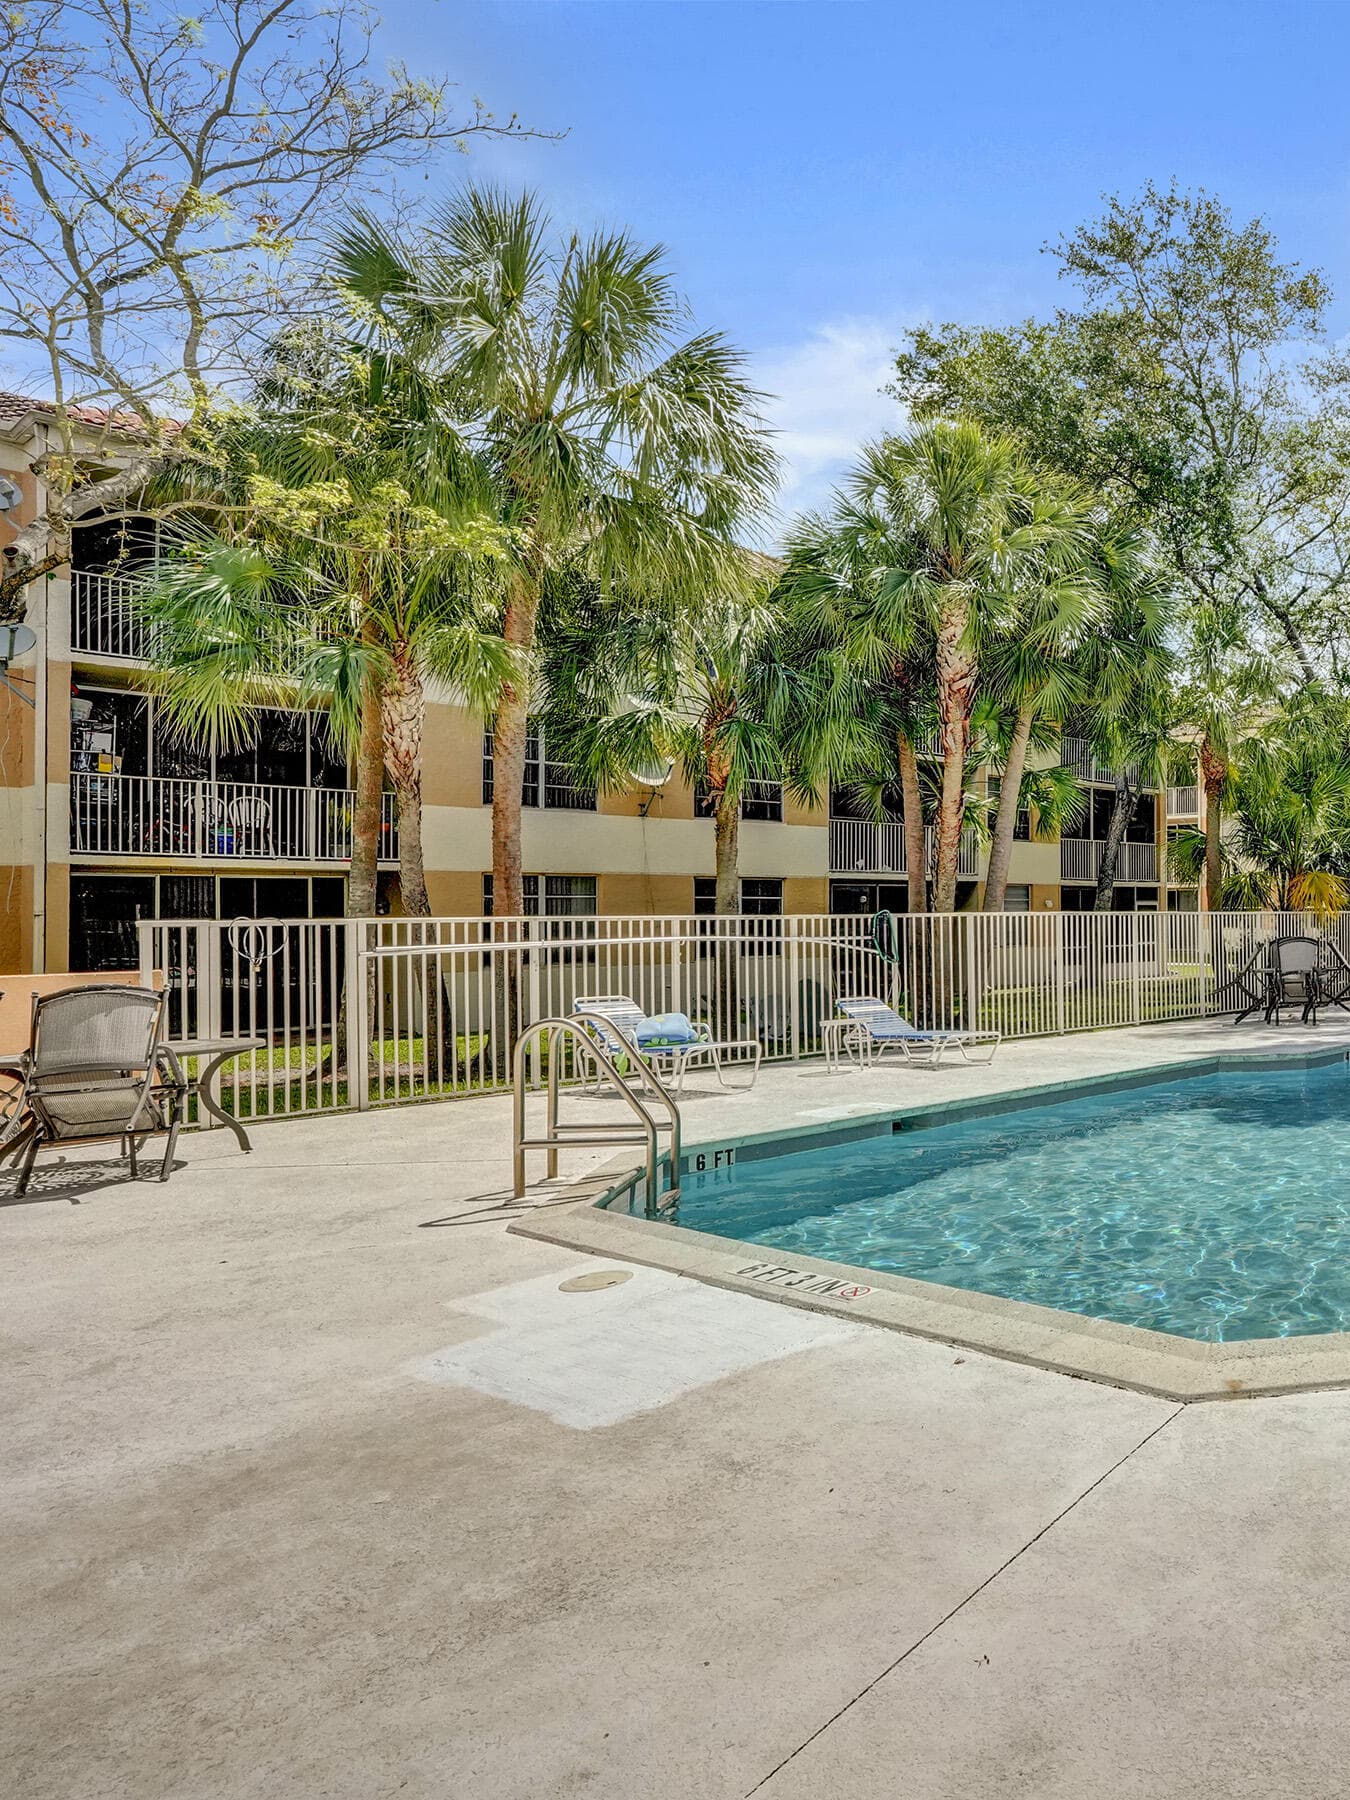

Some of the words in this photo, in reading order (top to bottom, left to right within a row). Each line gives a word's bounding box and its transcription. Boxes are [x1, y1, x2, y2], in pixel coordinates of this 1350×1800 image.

[696, 1153, 706, 1171] 6
[714, 1148, 734, 1168] FT.
[736, 1263, 768, 1275] 6
[752, 1266, 799, 1282] FT
[784, 1274, 817, 1286] 3
[803, 1278, 850, 1294] IN
